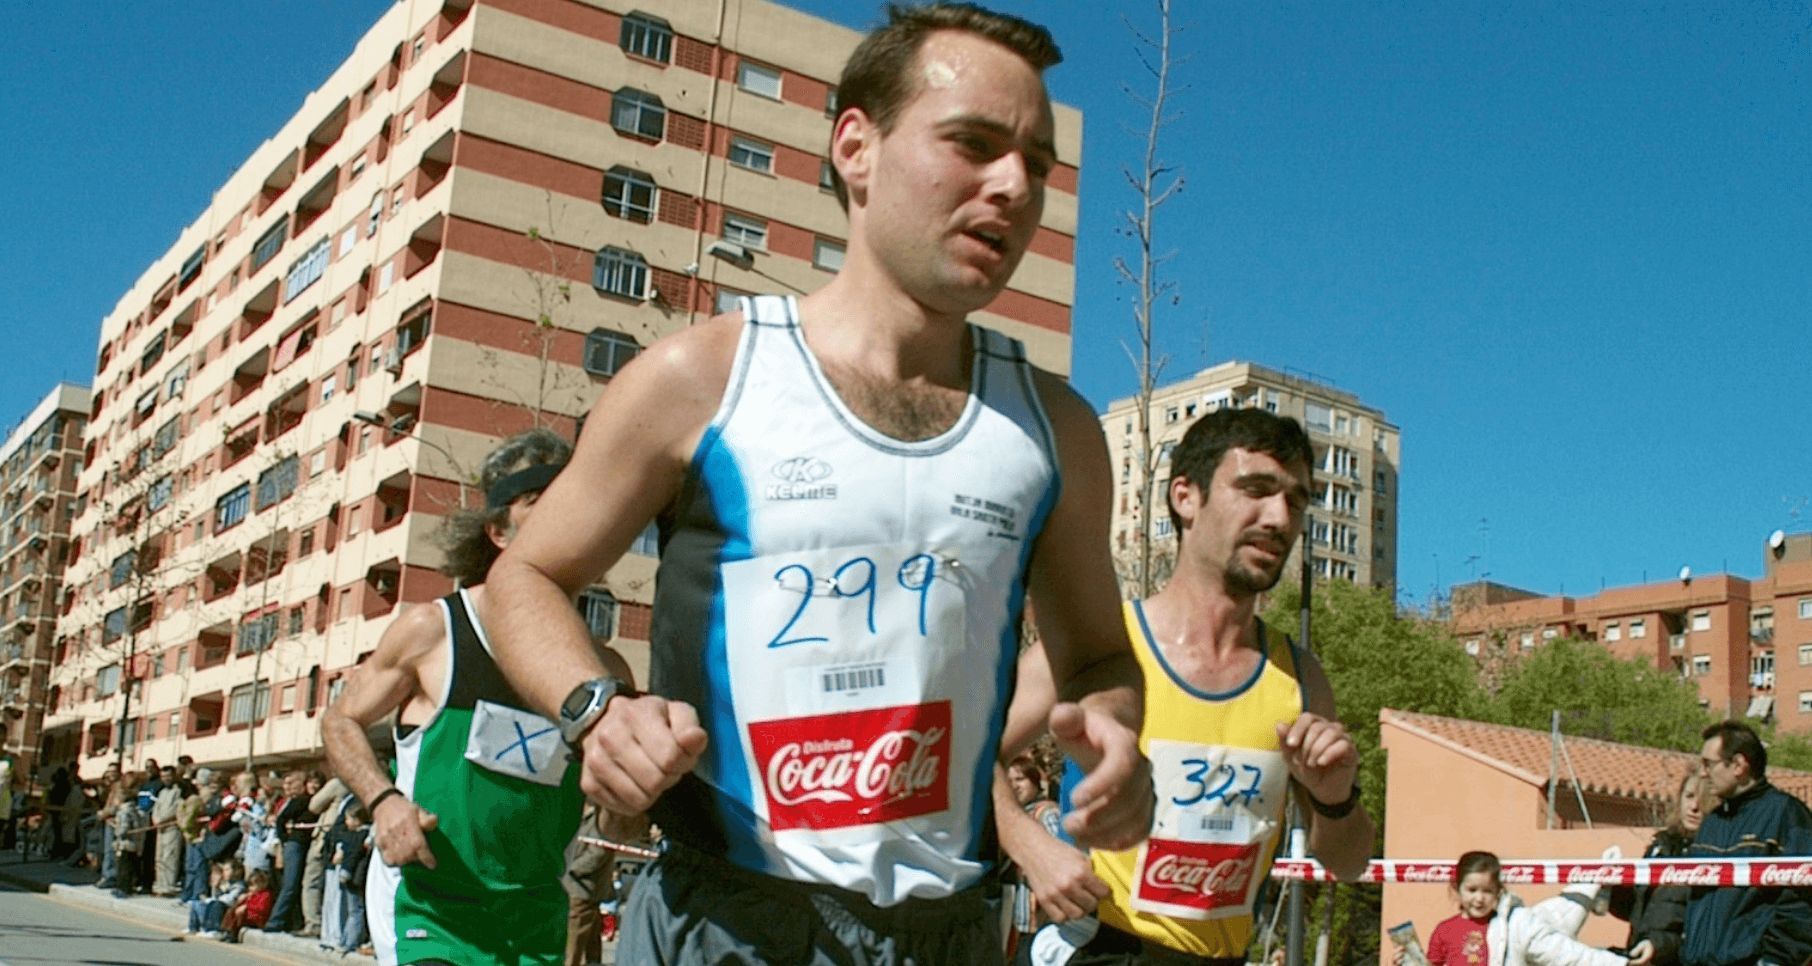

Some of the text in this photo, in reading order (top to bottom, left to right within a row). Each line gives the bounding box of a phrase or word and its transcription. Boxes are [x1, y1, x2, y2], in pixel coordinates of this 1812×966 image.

[767, 554, 936, 649] 299
[767, 726, 946, 806] Coca-Cola
[1172, 759, 1262, 807] 327
[1145, 853, 1254, 897] Coca-Cola
[1659, 864, 1723, 885] Coca-Cola
